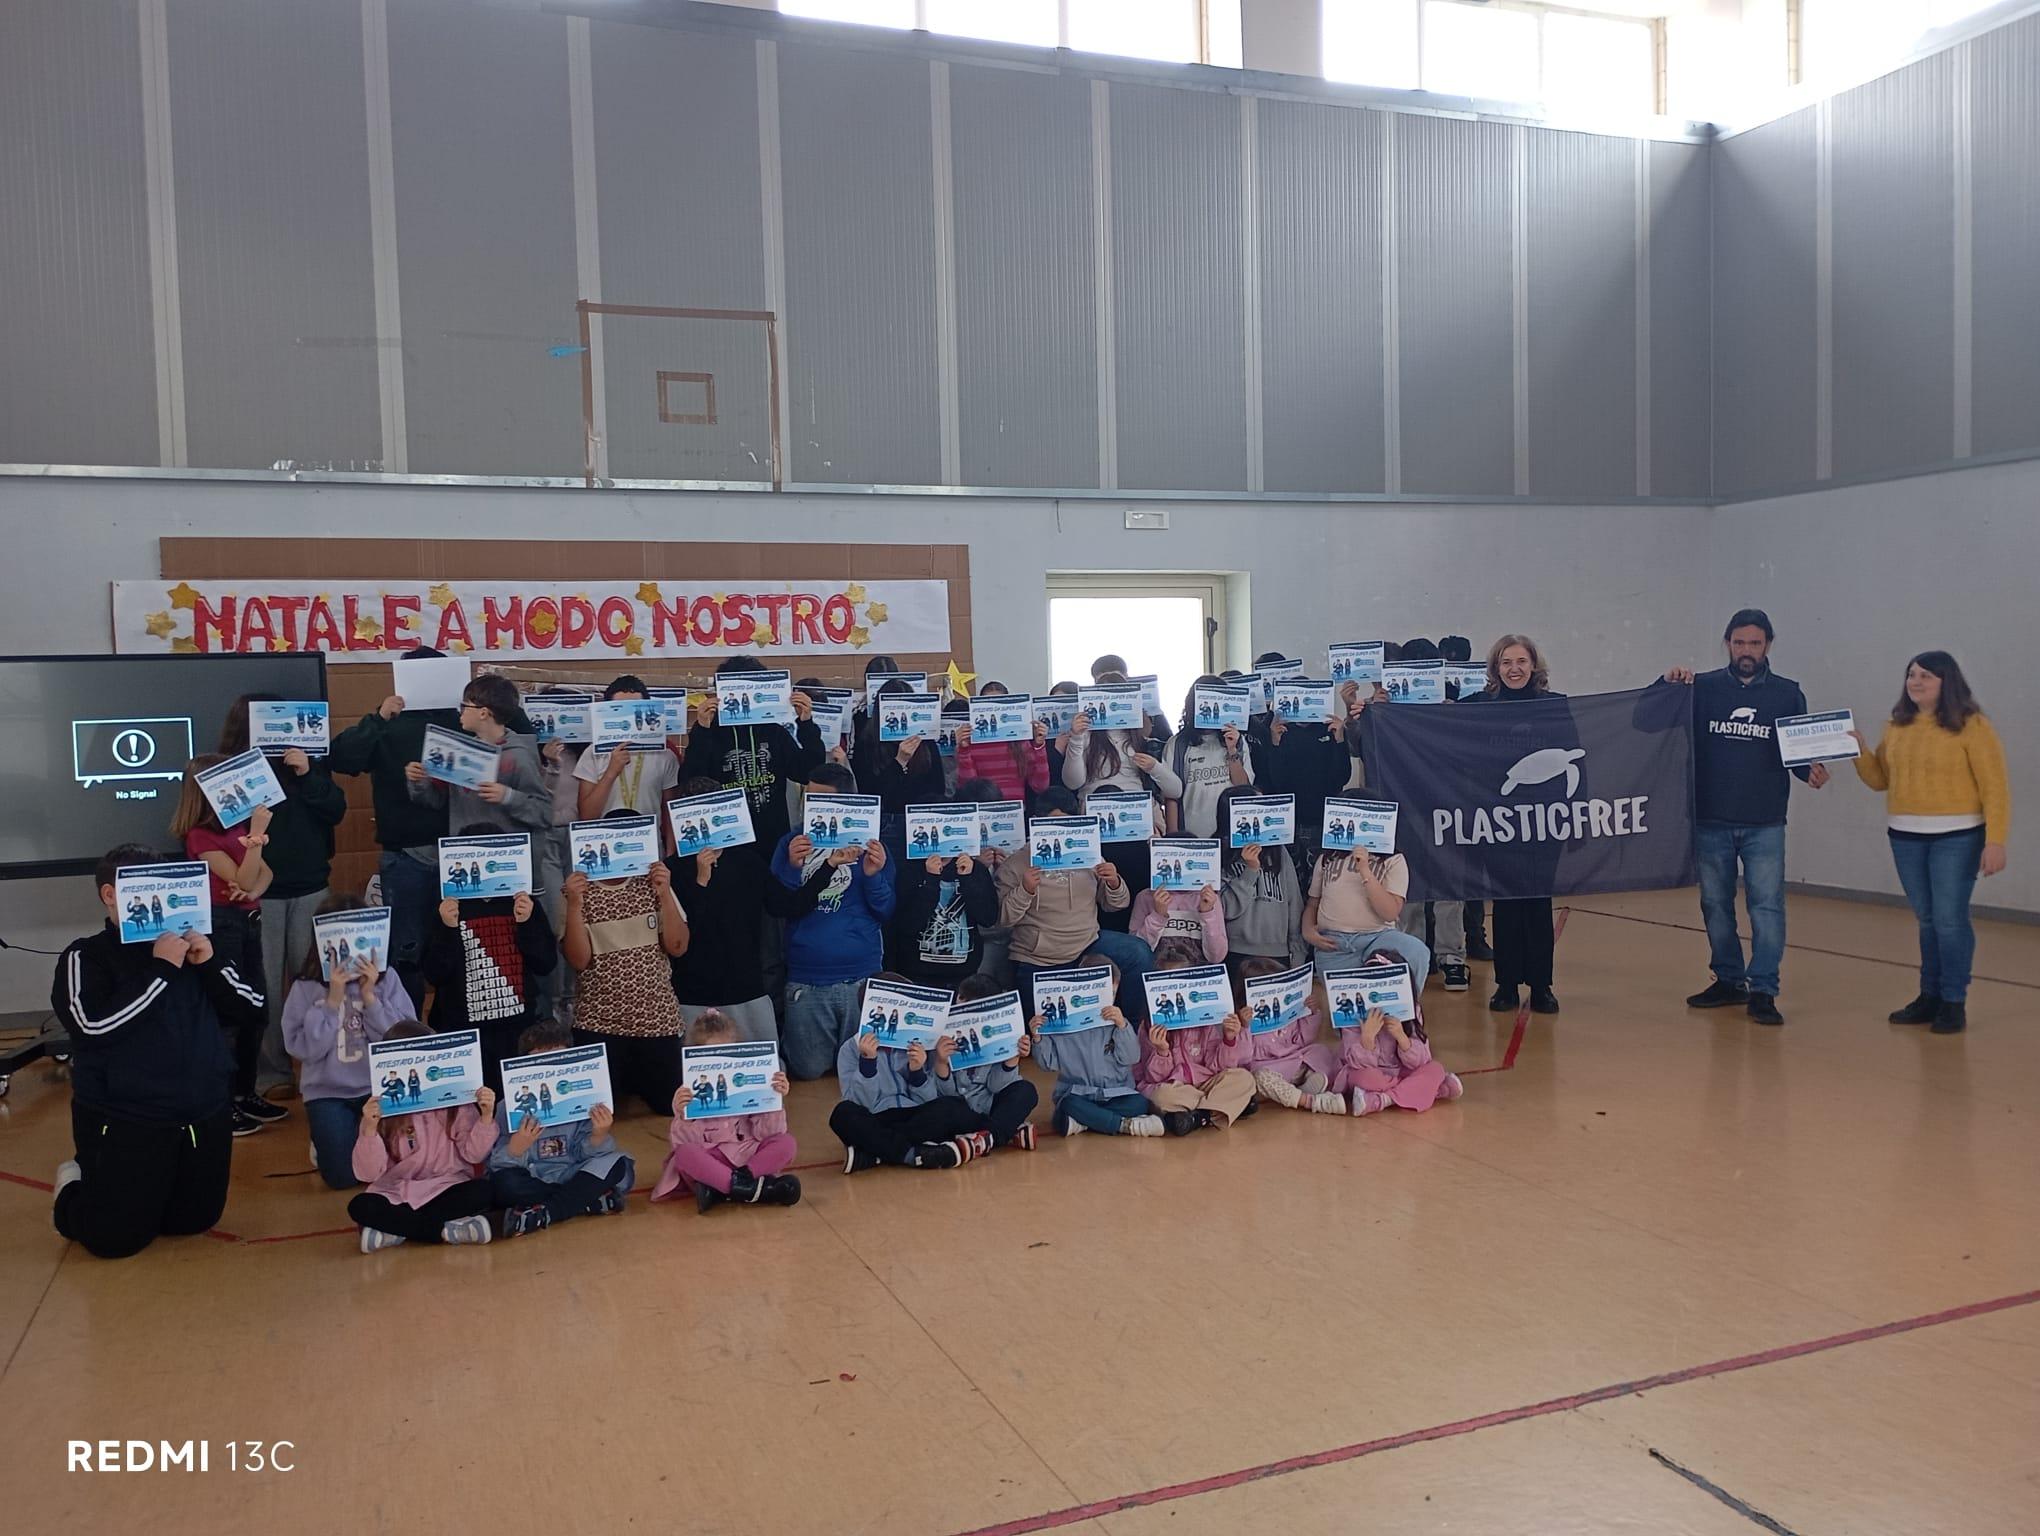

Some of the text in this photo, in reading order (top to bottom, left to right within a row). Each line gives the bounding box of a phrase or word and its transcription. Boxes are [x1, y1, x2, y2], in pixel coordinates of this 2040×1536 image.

[194, 594, 856, 653] NATALE A MODO NOSTRO
[1709, 720, 1772, 739] PLASTICFREE
[1786, 727, 1809, 737] SIAMO
[1811, 724, 1831, 734] STATI
[130, 790, 157, 799] Signal
[1433, 796, 1649, 846] PLASTICFREE
[443, 851, 476, 860] ATTESTATO
[121, 879, 204, 894] ATTESTATO DA SUPER EROE
[1037, 986, 1062, 994] ATTESTATO
[1150, 984, 1178, 992] ATTESTATO
[868, 995, 899, 1006] ATTESTATO
[908, 1001, 929, 1010] SUPER
[928, 1004, 944, 1012] EROE
[375, 1048, 472, 1069] ATTESTATO DA SUPER EROE
[687, 1062, 722, 1072] ATTESTATO
[733, 1060, 754, 1068] SUPER
[755, 1058, 771, 1066] EROE
[508, 1061, 599, 1085] ATTESTATO DA SUPER EROE
